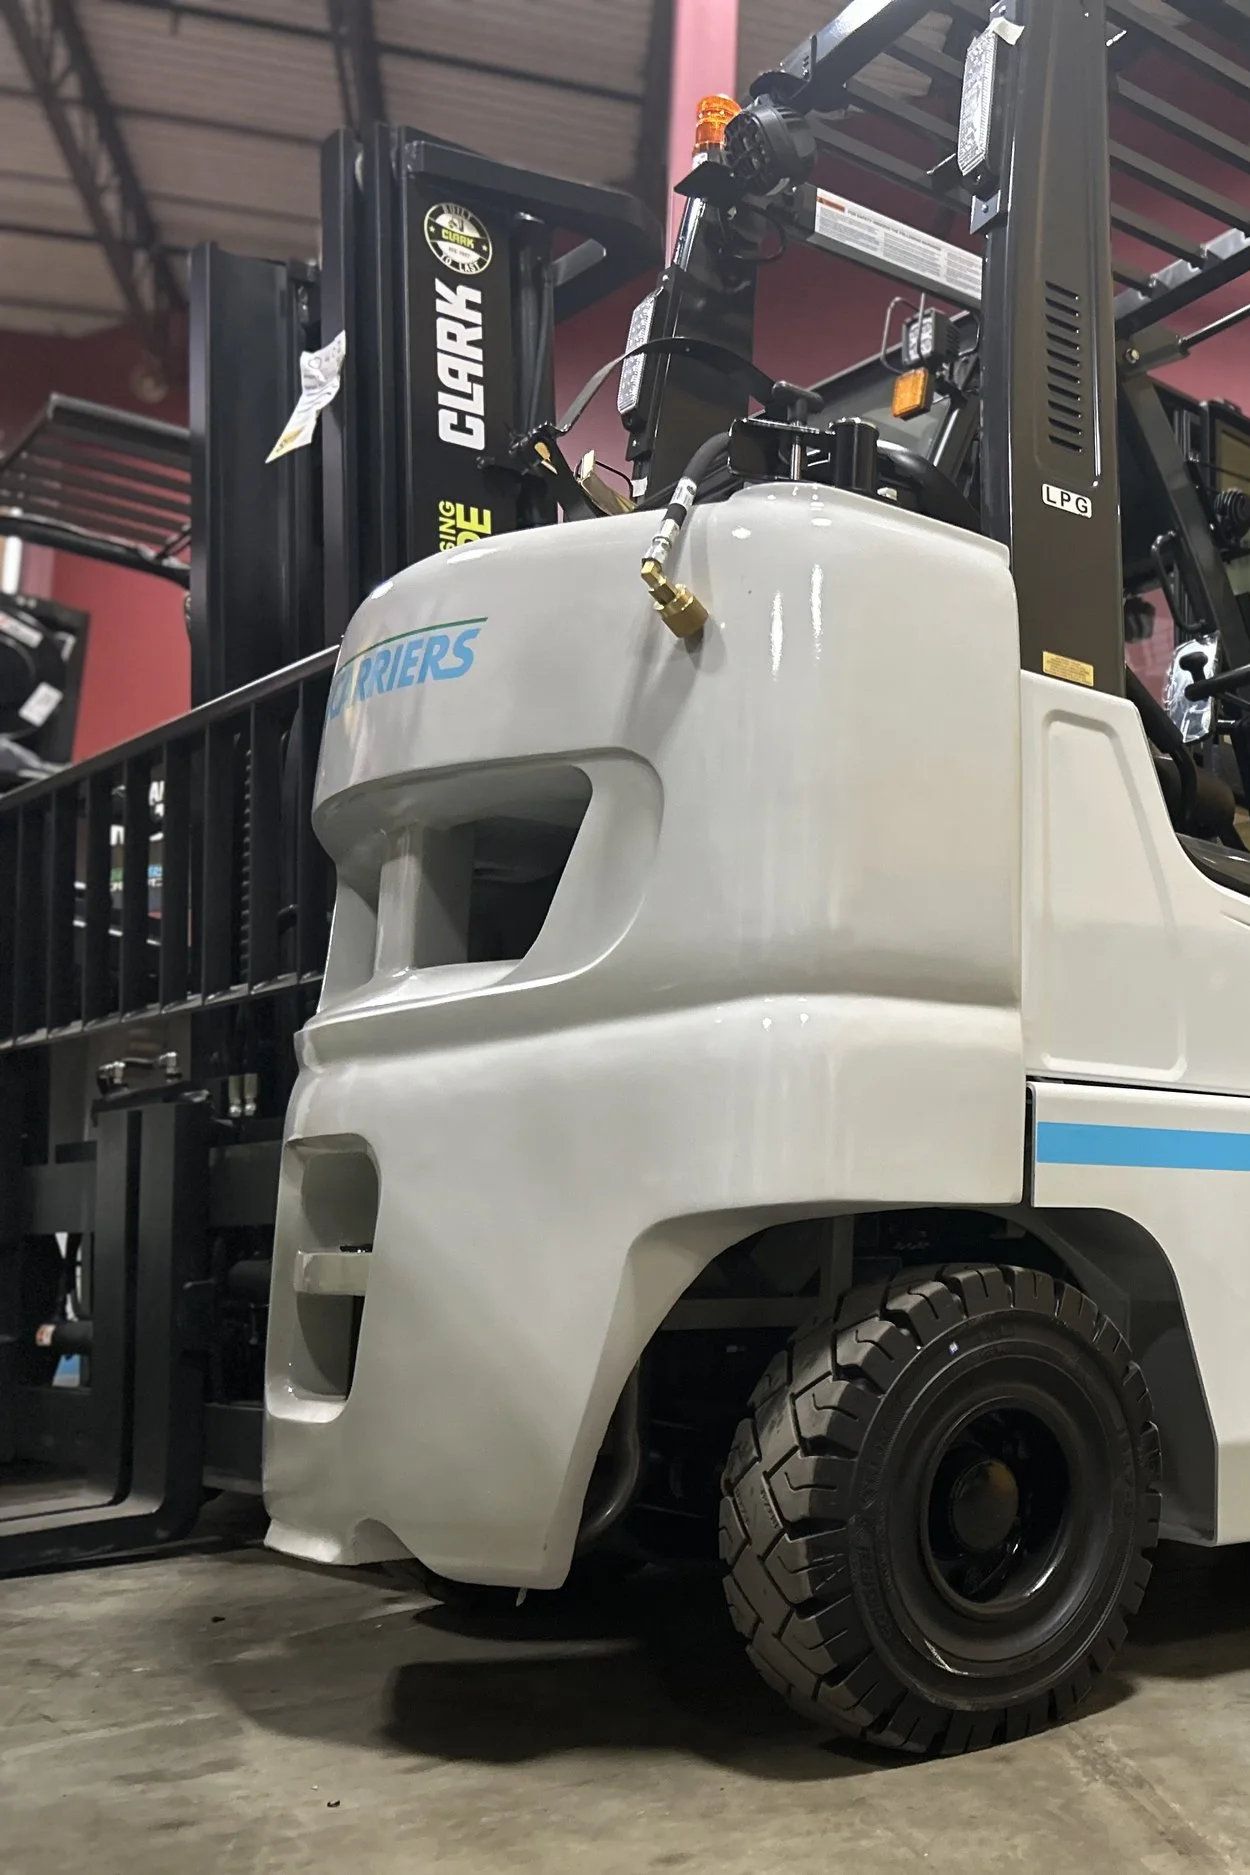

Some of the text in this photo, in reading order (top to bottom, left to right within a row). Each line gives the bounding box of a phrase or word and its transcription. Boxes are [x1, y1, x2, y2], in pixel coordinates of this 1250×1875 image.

[441, 228, 475, 249] CLARK
[440, 254, 481, 273] TO LAST
[434, 277, 485, 450] CLARK
[1045, 485, 1089, 514] LPG
